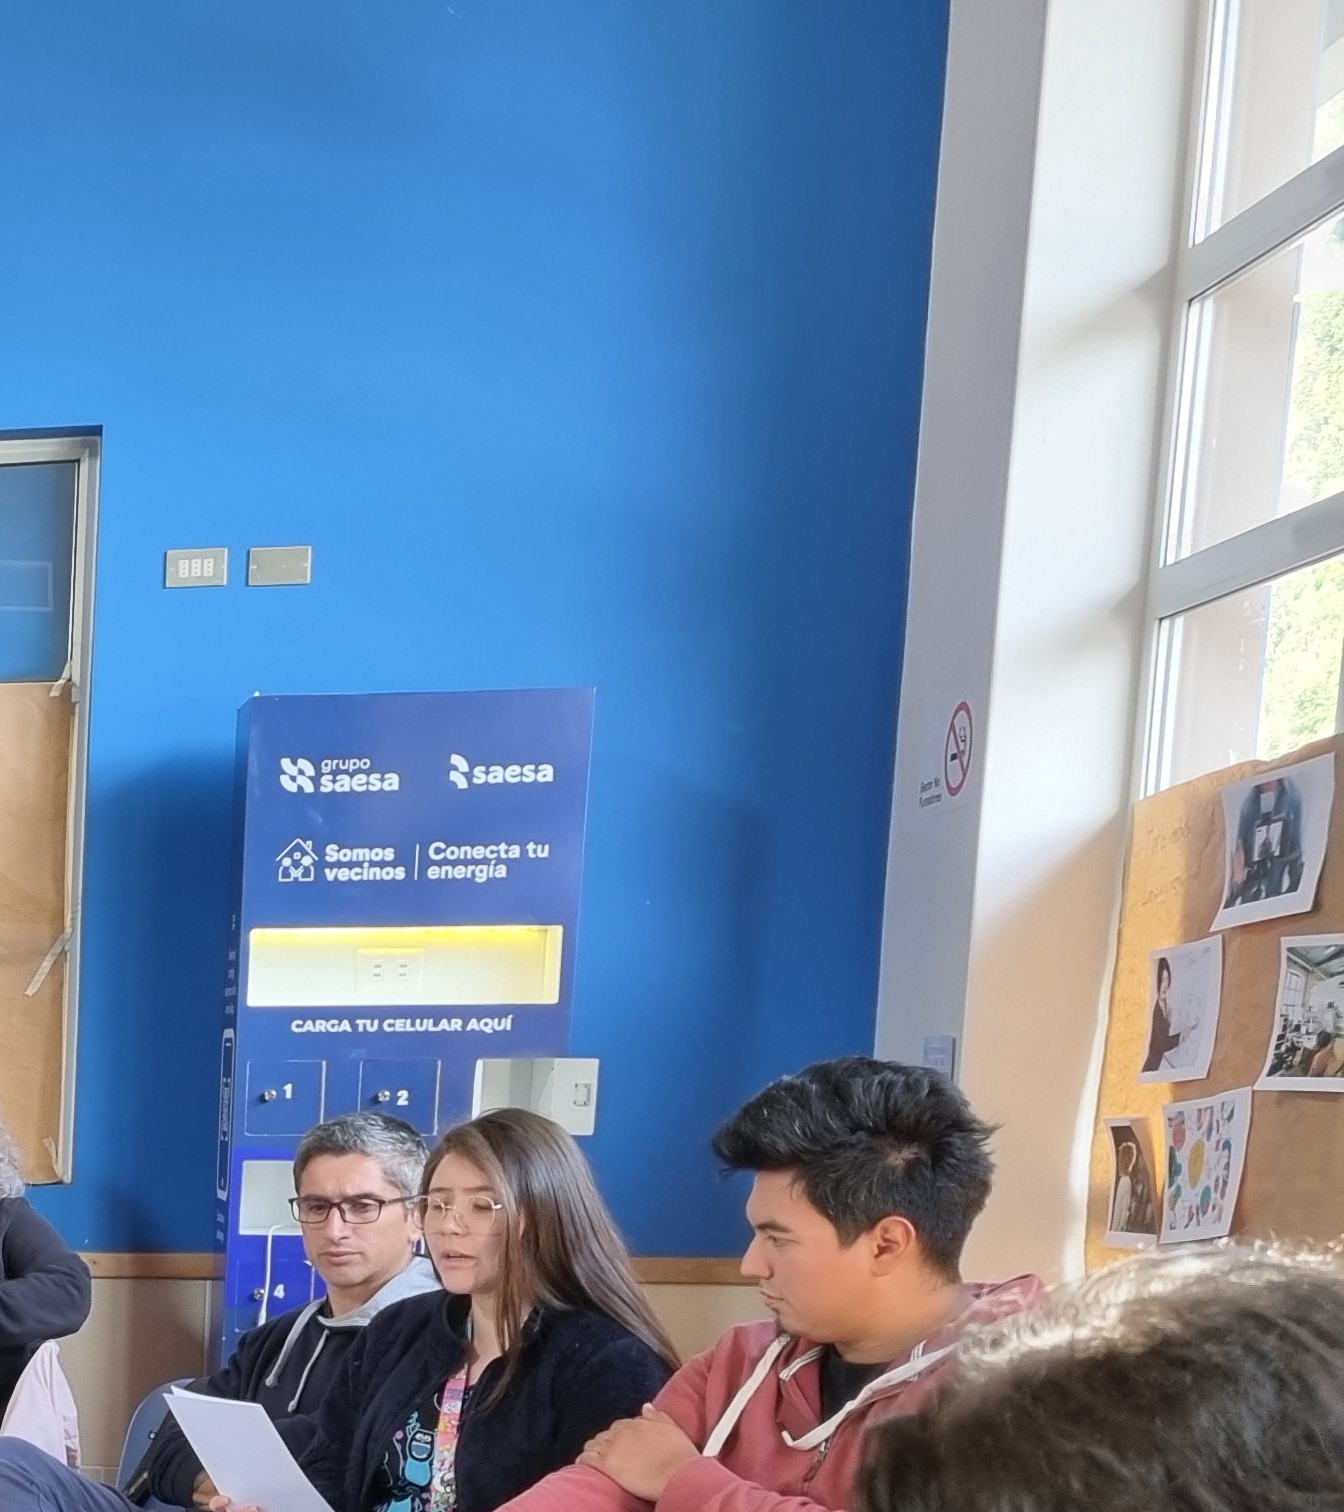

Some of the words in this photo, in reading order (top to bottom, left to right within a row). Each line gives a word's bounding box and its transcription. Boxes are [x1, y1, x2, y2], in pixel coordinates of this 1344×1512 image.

[320, 757, 371, 774] grupo
[472, 763, 554, 785] saesa
[319, 772, 400, 793] saesa
[324, 843, 396, 863] Somos
[428, 841, 521, 861] Conecta
[525, 841, 550, 859] tu
[324, 862, 406, 882] vecinos
[427, 860, 508, 884] energía
[291, 1019, 352, 1033] CARGA
[355, 1019, 379, 1032] TU
[382, 1018, 463, 1032] CELULAR
[466, 1014, 514, 1033] AQUÍ
[283, 1083, 293, 1100] 1
[396, 1089, 409, 1106] 2
[273, 1284, 285, 1299] 4
